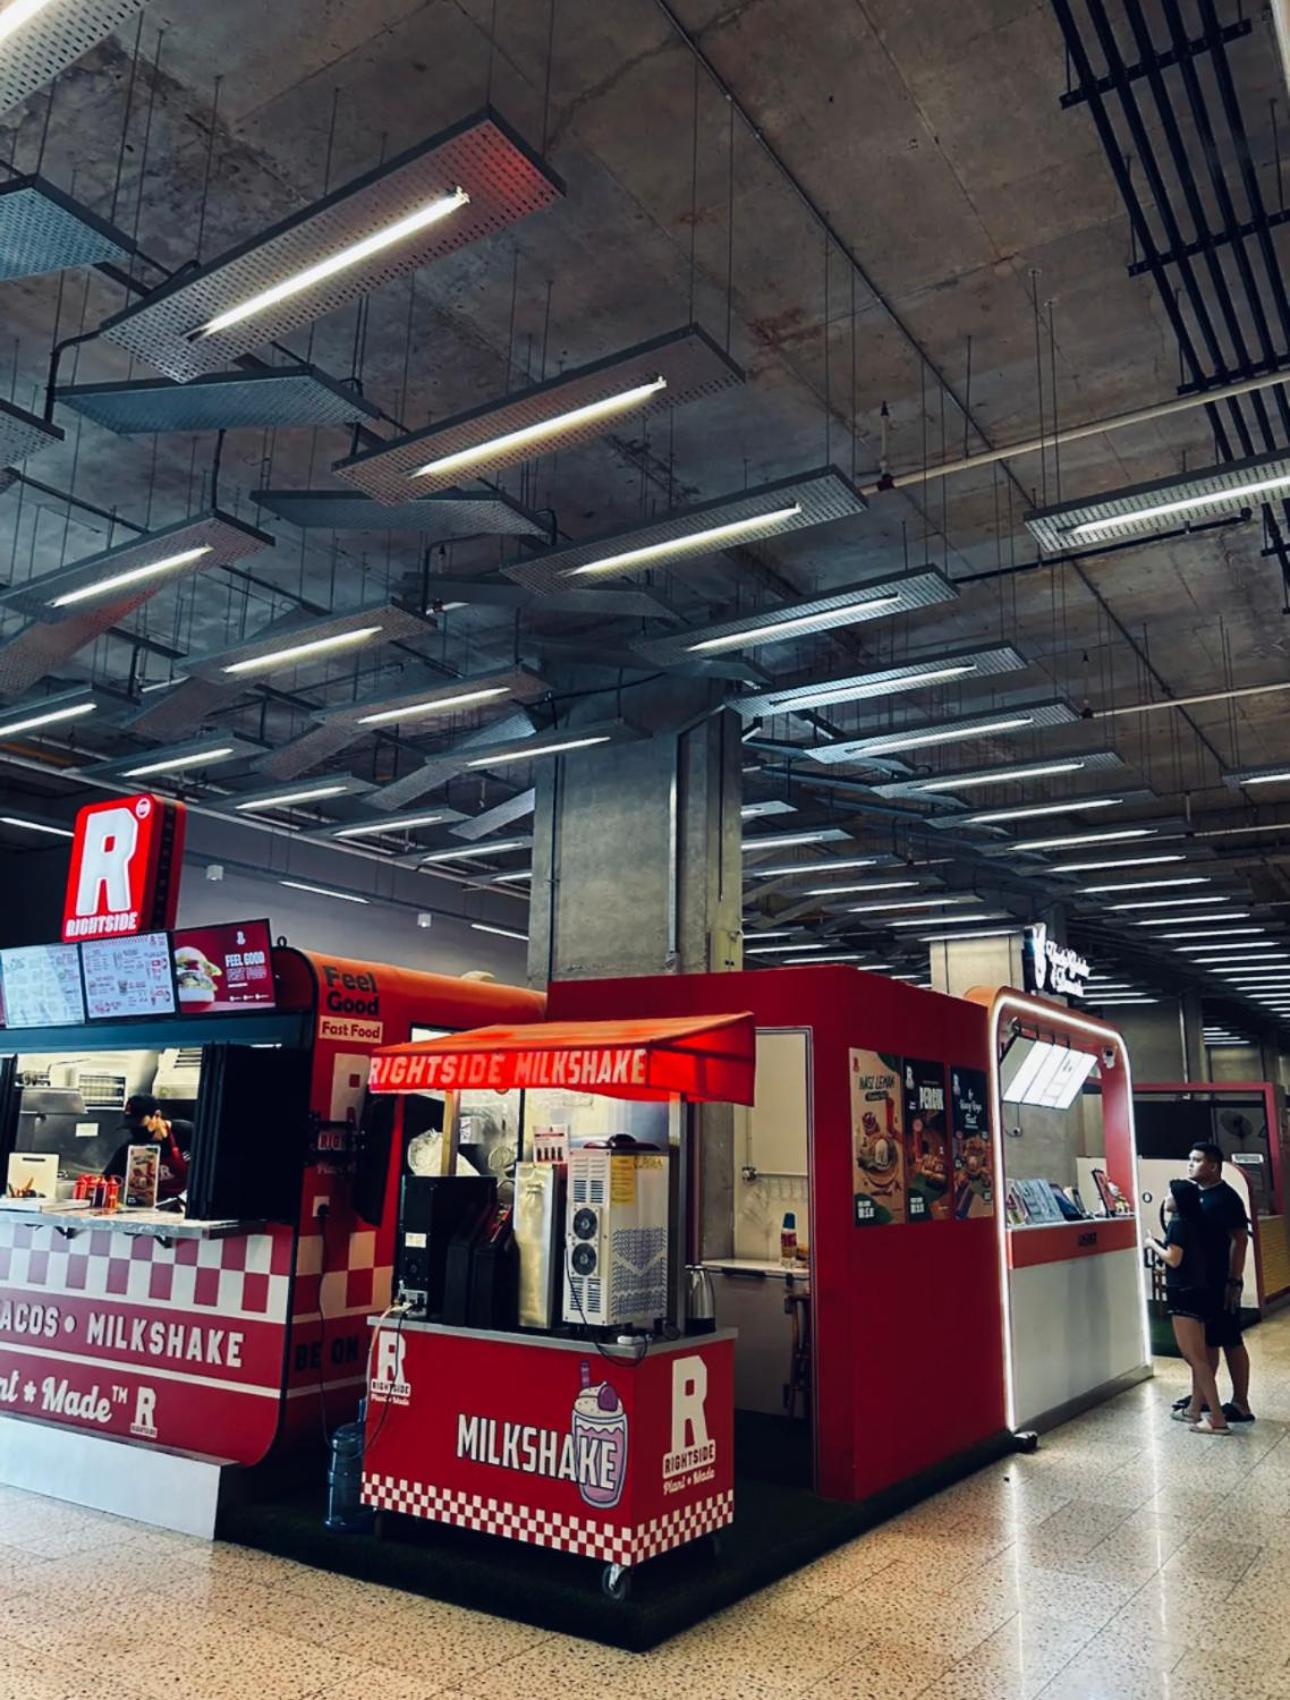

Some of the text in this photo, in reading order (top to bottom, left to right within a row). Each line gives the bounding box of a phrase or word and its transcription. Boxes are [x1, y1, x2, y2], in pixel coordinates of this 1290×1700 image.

[76, 807, 138, 916] R
[66, 912, 138, 937] RIGHTSIDE
[324, 965, 377, 993] Feel
[327, 992, 379, 1016] Good
[321, 1021, 380, 1040] Fast Food
[367, 1048, 646, 1086] RIGHTSIDE MILKSHAKE
[87, 1312, 245, 1368] MILKSHAKE
[377, 1330, 406, 1384] R
[672, 1355, 708, 1450] R
[456, 1413, 617, 1490] MILKSHAKE
[665, 1444, 715, 1474] RIGHTSIDE
